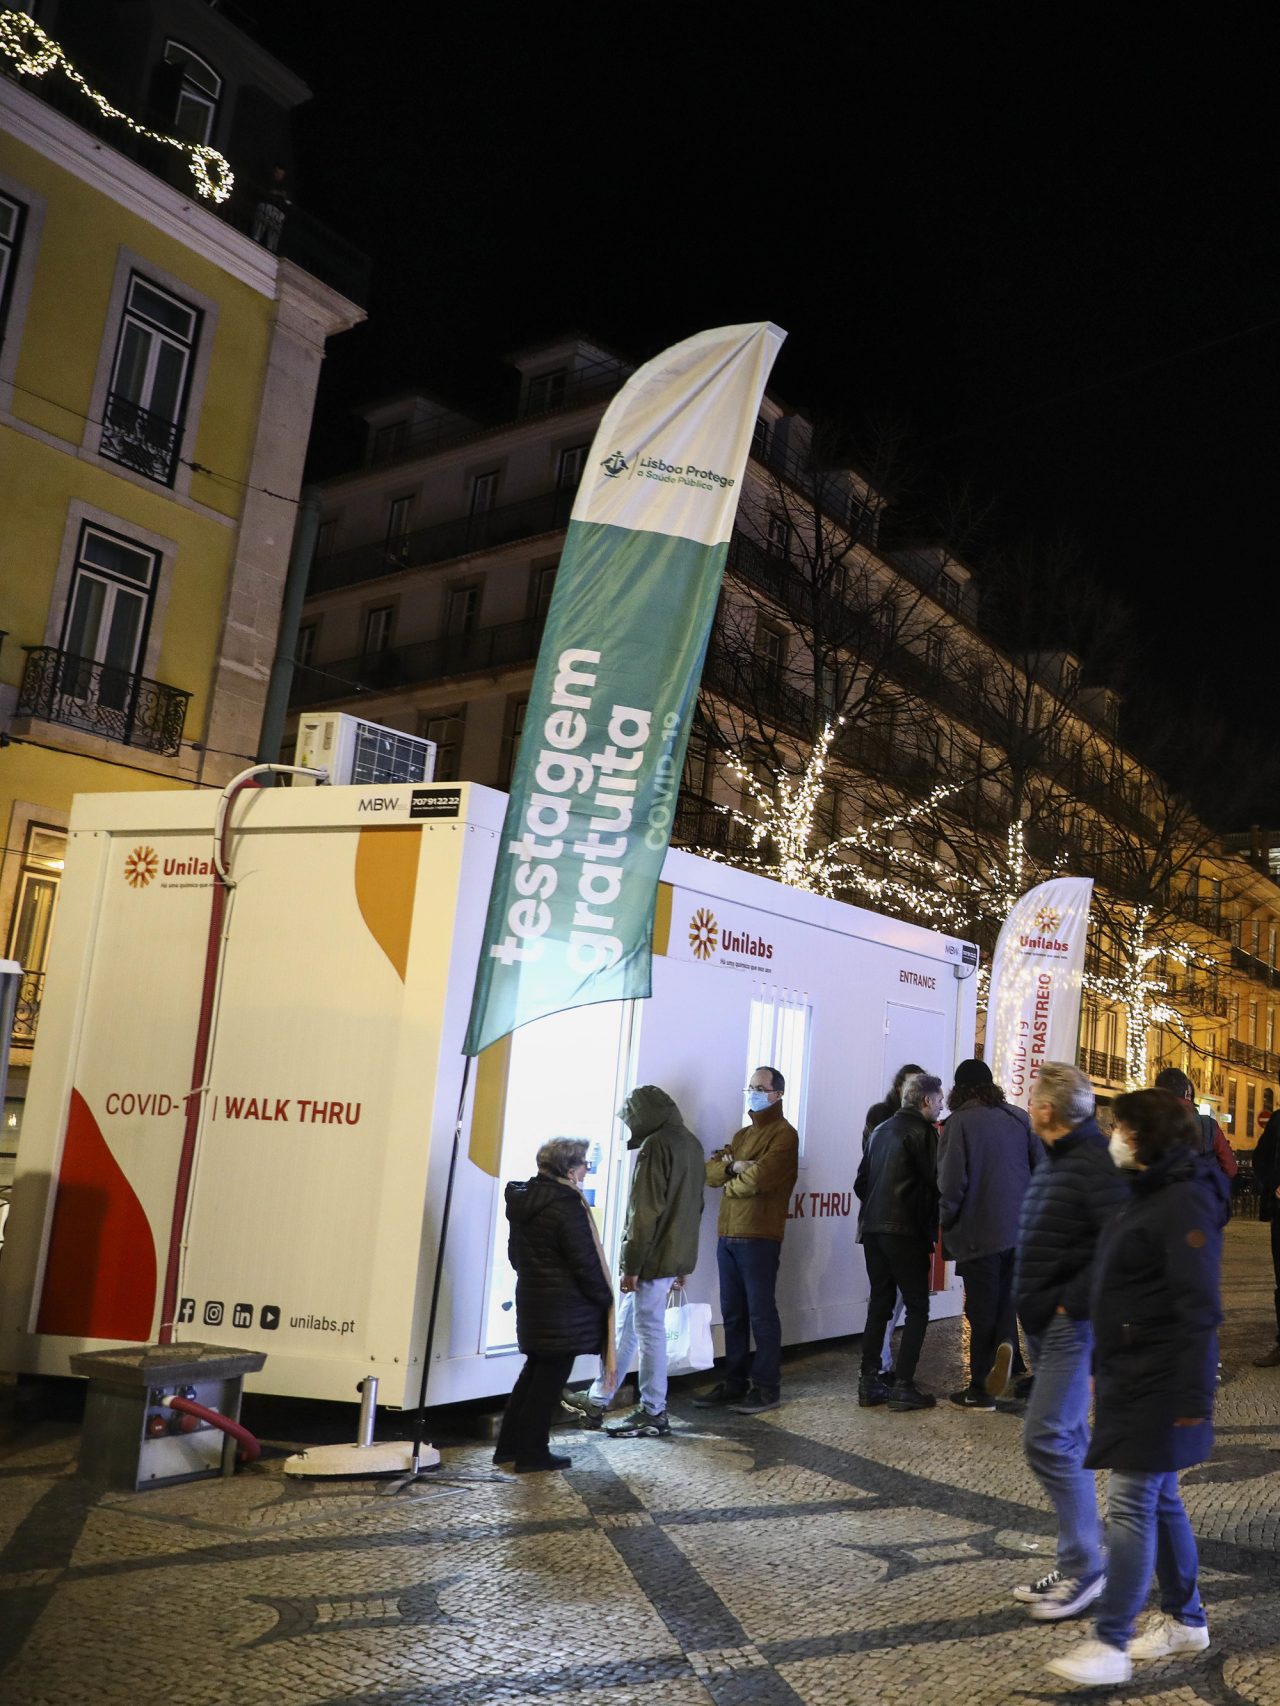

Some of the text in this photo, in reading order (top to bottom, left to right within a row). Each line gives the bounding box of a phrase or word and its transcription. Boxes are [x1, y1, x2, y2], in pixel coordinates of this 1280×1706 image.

[640, 457, 735, 488] Lisboa Protege
[645, 470, 676, 484] Saúde
[678, 477, 713, 491] Pública
[645, 711, 681, 850] COVID-19
[358, 798, 399, 812] MBW
[491, 648, 602, 965] testagem
[566, 704, 652, 972] gratuita
[722, 929, 773, 959] Unilabs
[1019, 935, 1069, 952] Unilabs
[899, 969, 936, 990] ENTRANCE
[1034, 973, 1052, 1054] RASTREIO
[1011, 1020, 1029, 1096] COVID-19
[106, 1093, 190, 1117] COVID-1
[225, 1096, 290, 1121] WALK
[297, 1100, 362, 1125] THRU
[810, 1192, 851, 1217] THRU
[290, 1315, 356, 1335] unilabs.pt
